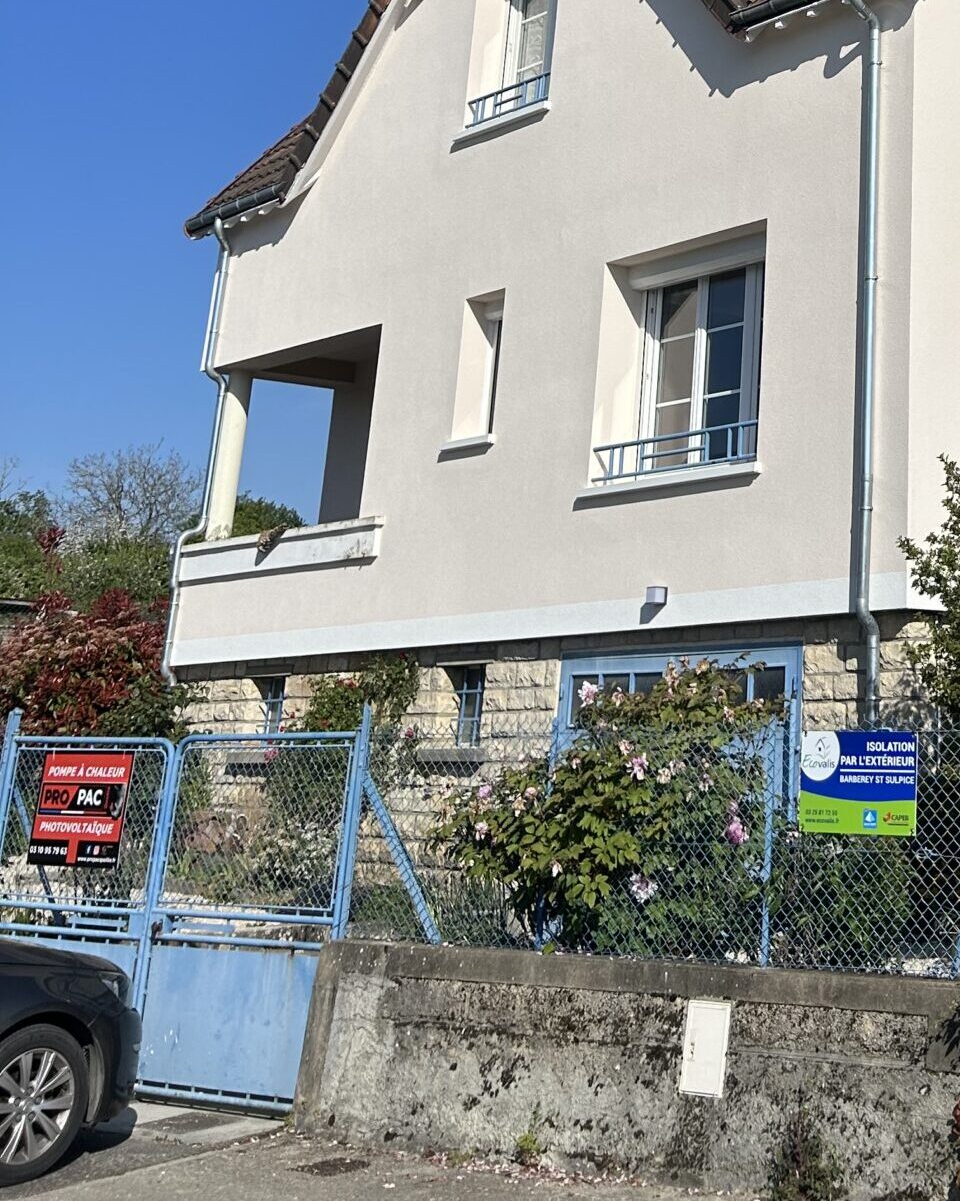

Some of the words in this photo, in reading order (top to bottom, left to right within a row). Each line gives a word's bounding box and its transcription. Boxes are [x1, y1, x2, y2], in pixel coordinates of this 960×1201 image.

[867, 742, 915, 752] ISOLATION
[802, 754, 835, 769] Ecovalis
[840, 755, 857, 766] PAR
[859, 754, 915, 767] L'EXTÉRIEUR
[48, 766, 76, 777] POMPE
[77, 763, 84, 777] À
[86, 766, 125, 778] CHALEUR
[840, 775, 873, 784] BARBEREY
[875, 775, 884, 784] ST
[885, 775, 915, 785] SULPICE
[44, 789, 70, 805] PRO
[77, 789, 103, 806] PAC
[40, 821, 114, 836] PHOTOVOLTAÏQUE
